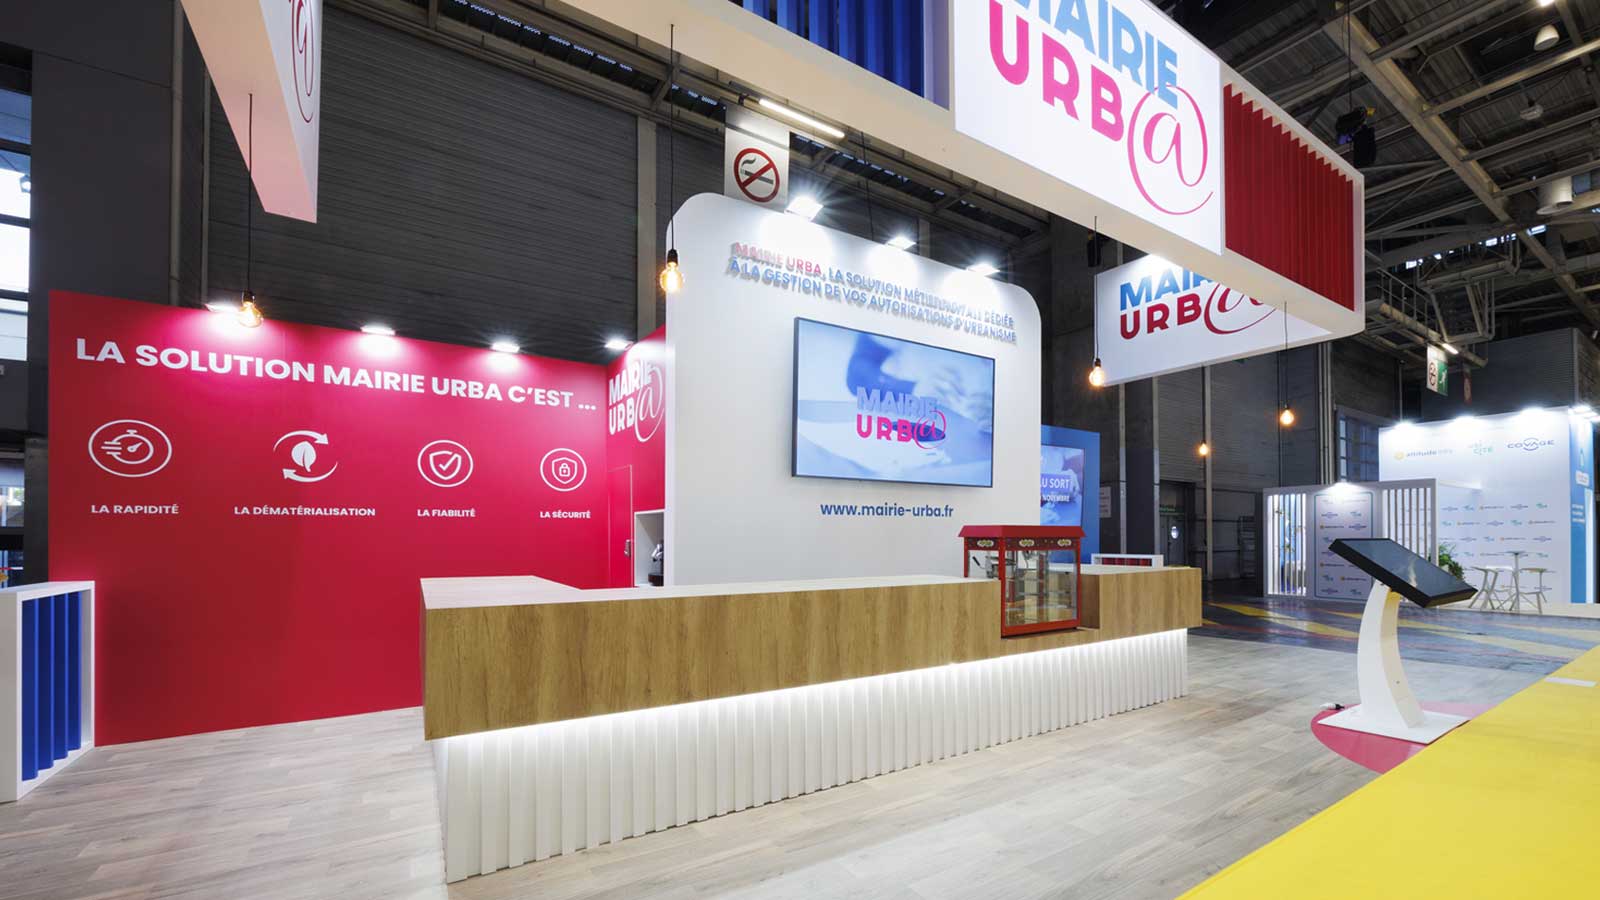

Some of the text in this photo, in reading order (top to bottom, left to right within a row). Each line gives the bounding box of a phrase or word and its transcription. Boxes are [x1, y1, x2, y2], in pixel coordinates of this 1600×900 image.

[786, 256, 826, 280] URBA,
[829, 267, 843, 281] LA
[846, 272, 901, 300] SOLUTION
[729, 256, 1016, 342] À LA GESTION DE VOS AUTORISATIONS D'URBANISME
[76, 338, 126, 364] LA
[135, 345, 315, 382] SOLUTION
[323, 365, 425, 393] MAIRIE
[432, 377, 502, 401] URBA
[1049, 478, 1070, 489] SORT
[91, 503, 179, 514] LA RAPIDITÉ
[234, 504, 376, 516] LA DÉMATÉRIALISATION
[417, 507, 476, 517] LA FIABILITÉ
[539, 510, 591, 519] LA SÉCURITÉ
[820, 502, 954, 517] www.mairie-urba.fr
